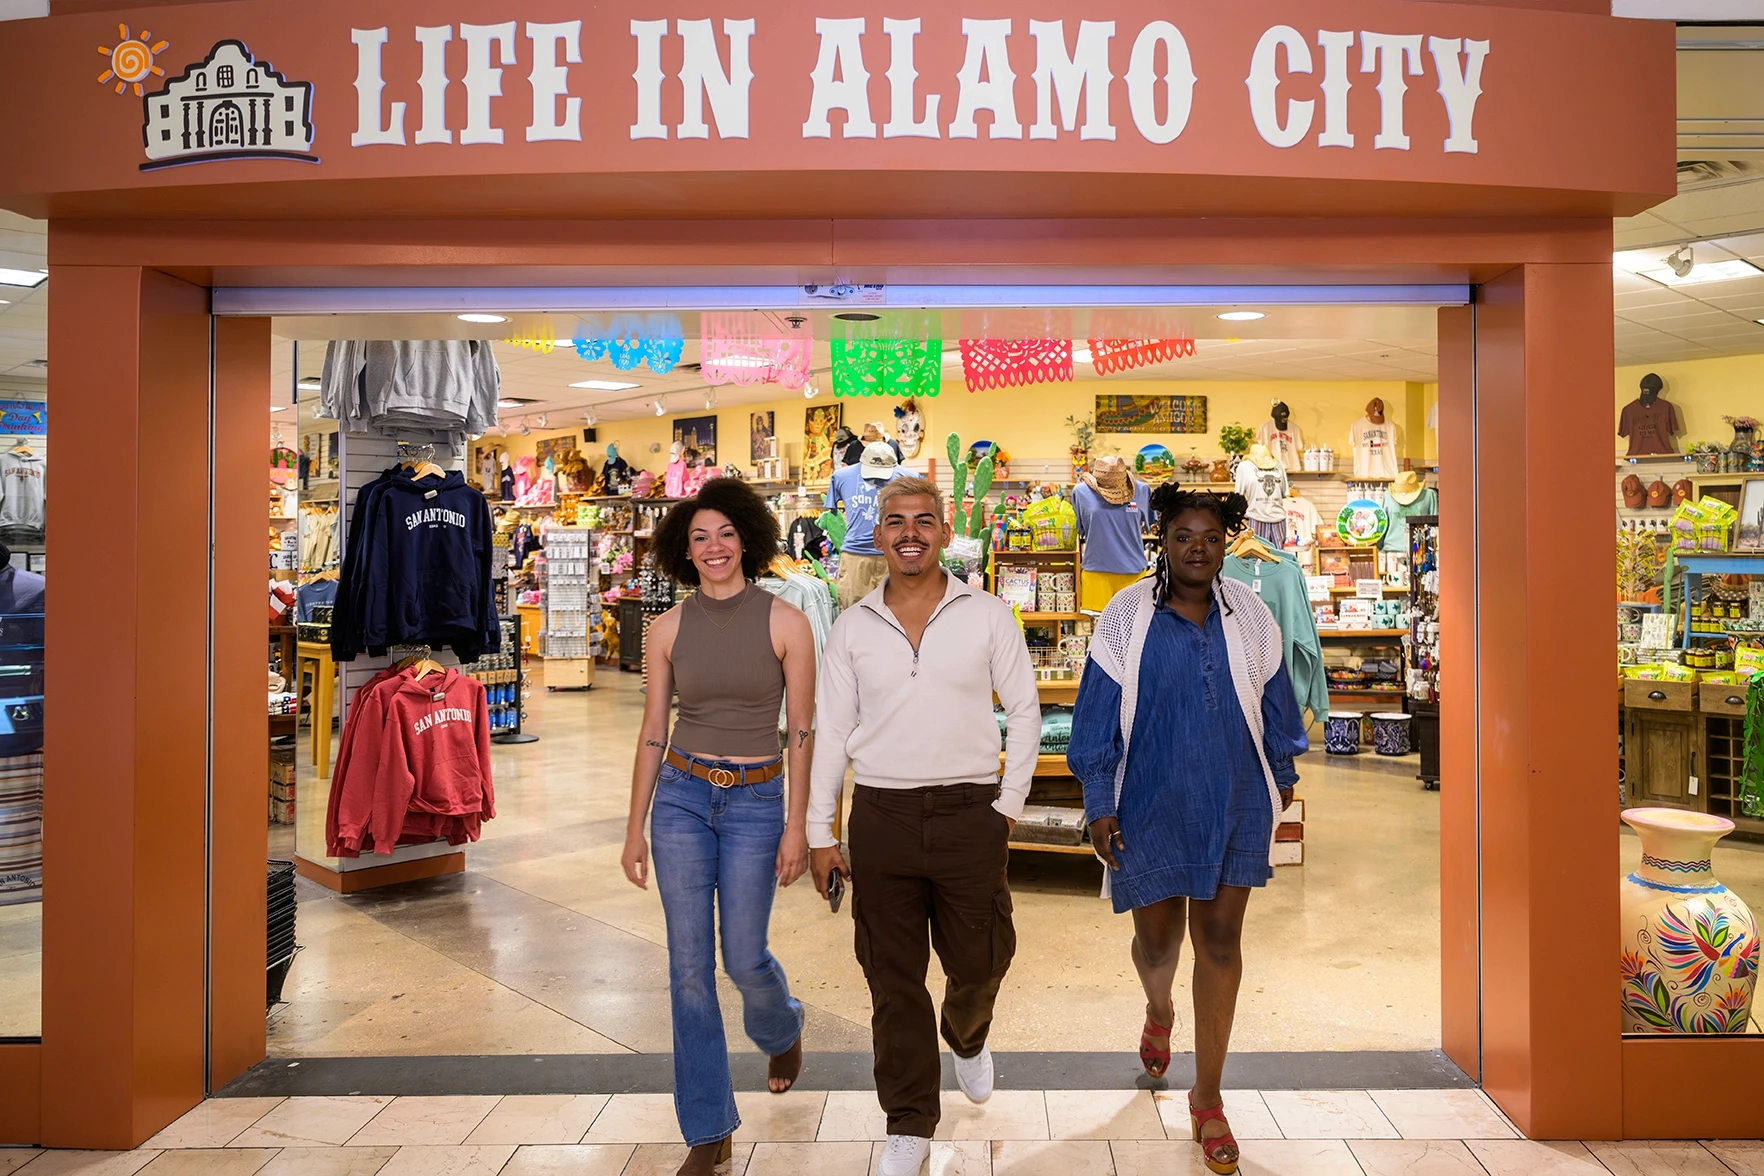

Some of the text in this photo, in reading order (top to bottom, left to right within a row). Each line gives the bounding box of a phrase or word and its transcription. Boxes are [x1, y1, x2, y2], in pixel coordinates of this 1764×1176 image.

[351, 16, 1490, 154] LIFE IN ALAMO CITY
[1149, 399, 1201, 414] WELCOME
[8, 411, 31, 424] Day
[1152, 411, 1195, 425] AMIGOS
[851, 494, 872, 508] San
[405, 507, 466, 531] SAN ANTONIO
[413, 707, 472, 736] SAN ANTONIO
[6, 873, 36, 887] ANTONIO
